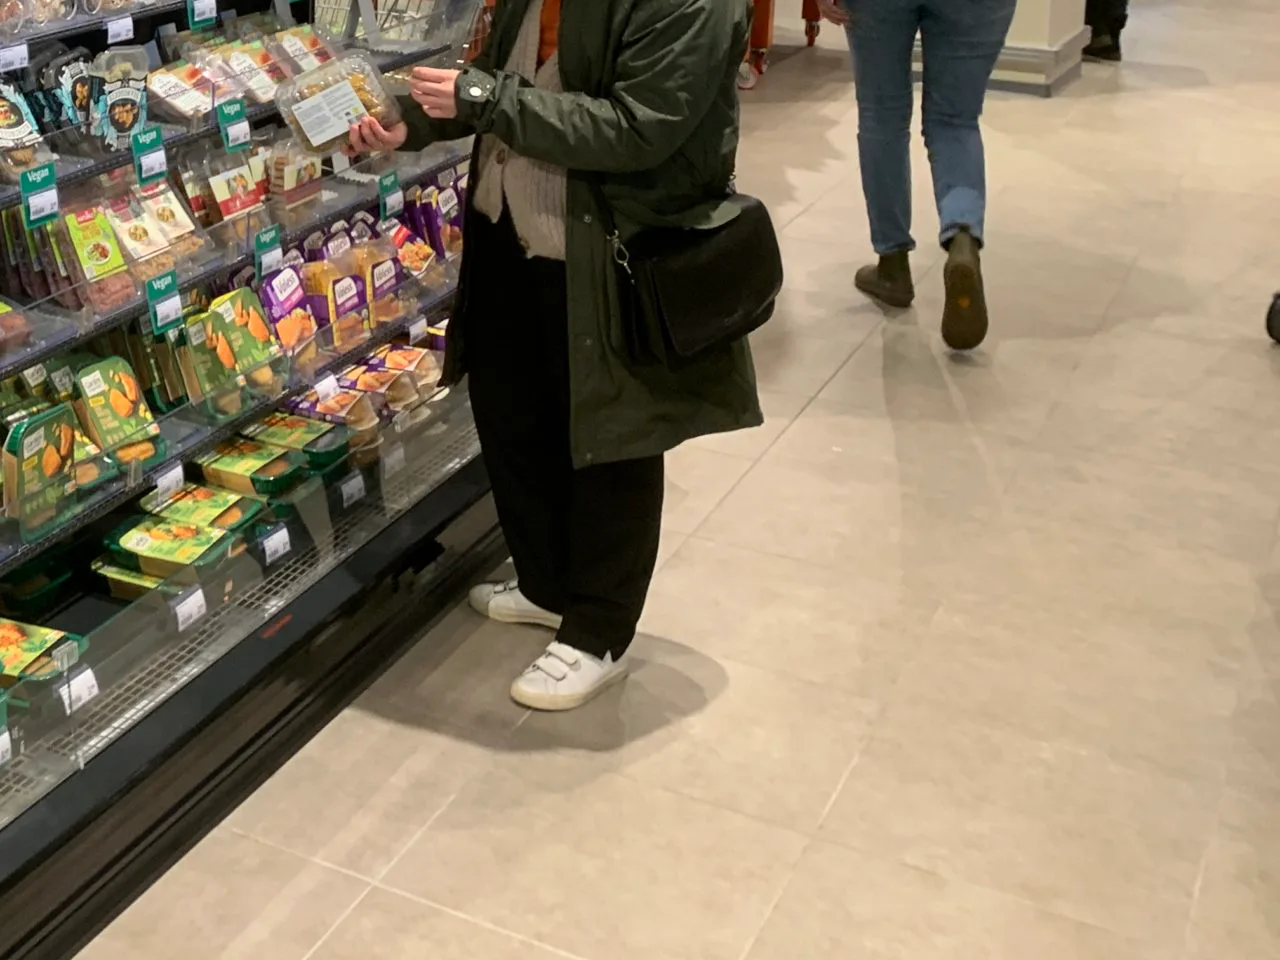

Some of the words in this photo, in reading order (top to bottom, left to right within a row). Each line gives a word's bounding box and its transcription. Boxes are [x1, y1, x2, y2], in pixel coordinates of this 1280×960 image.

[222, 102, 241, 115] Vegan
[137, 128, 157, 145] Vegan
[27, 167, 50, 183] Vegan
[151, 275, 173, 290] Vegan
